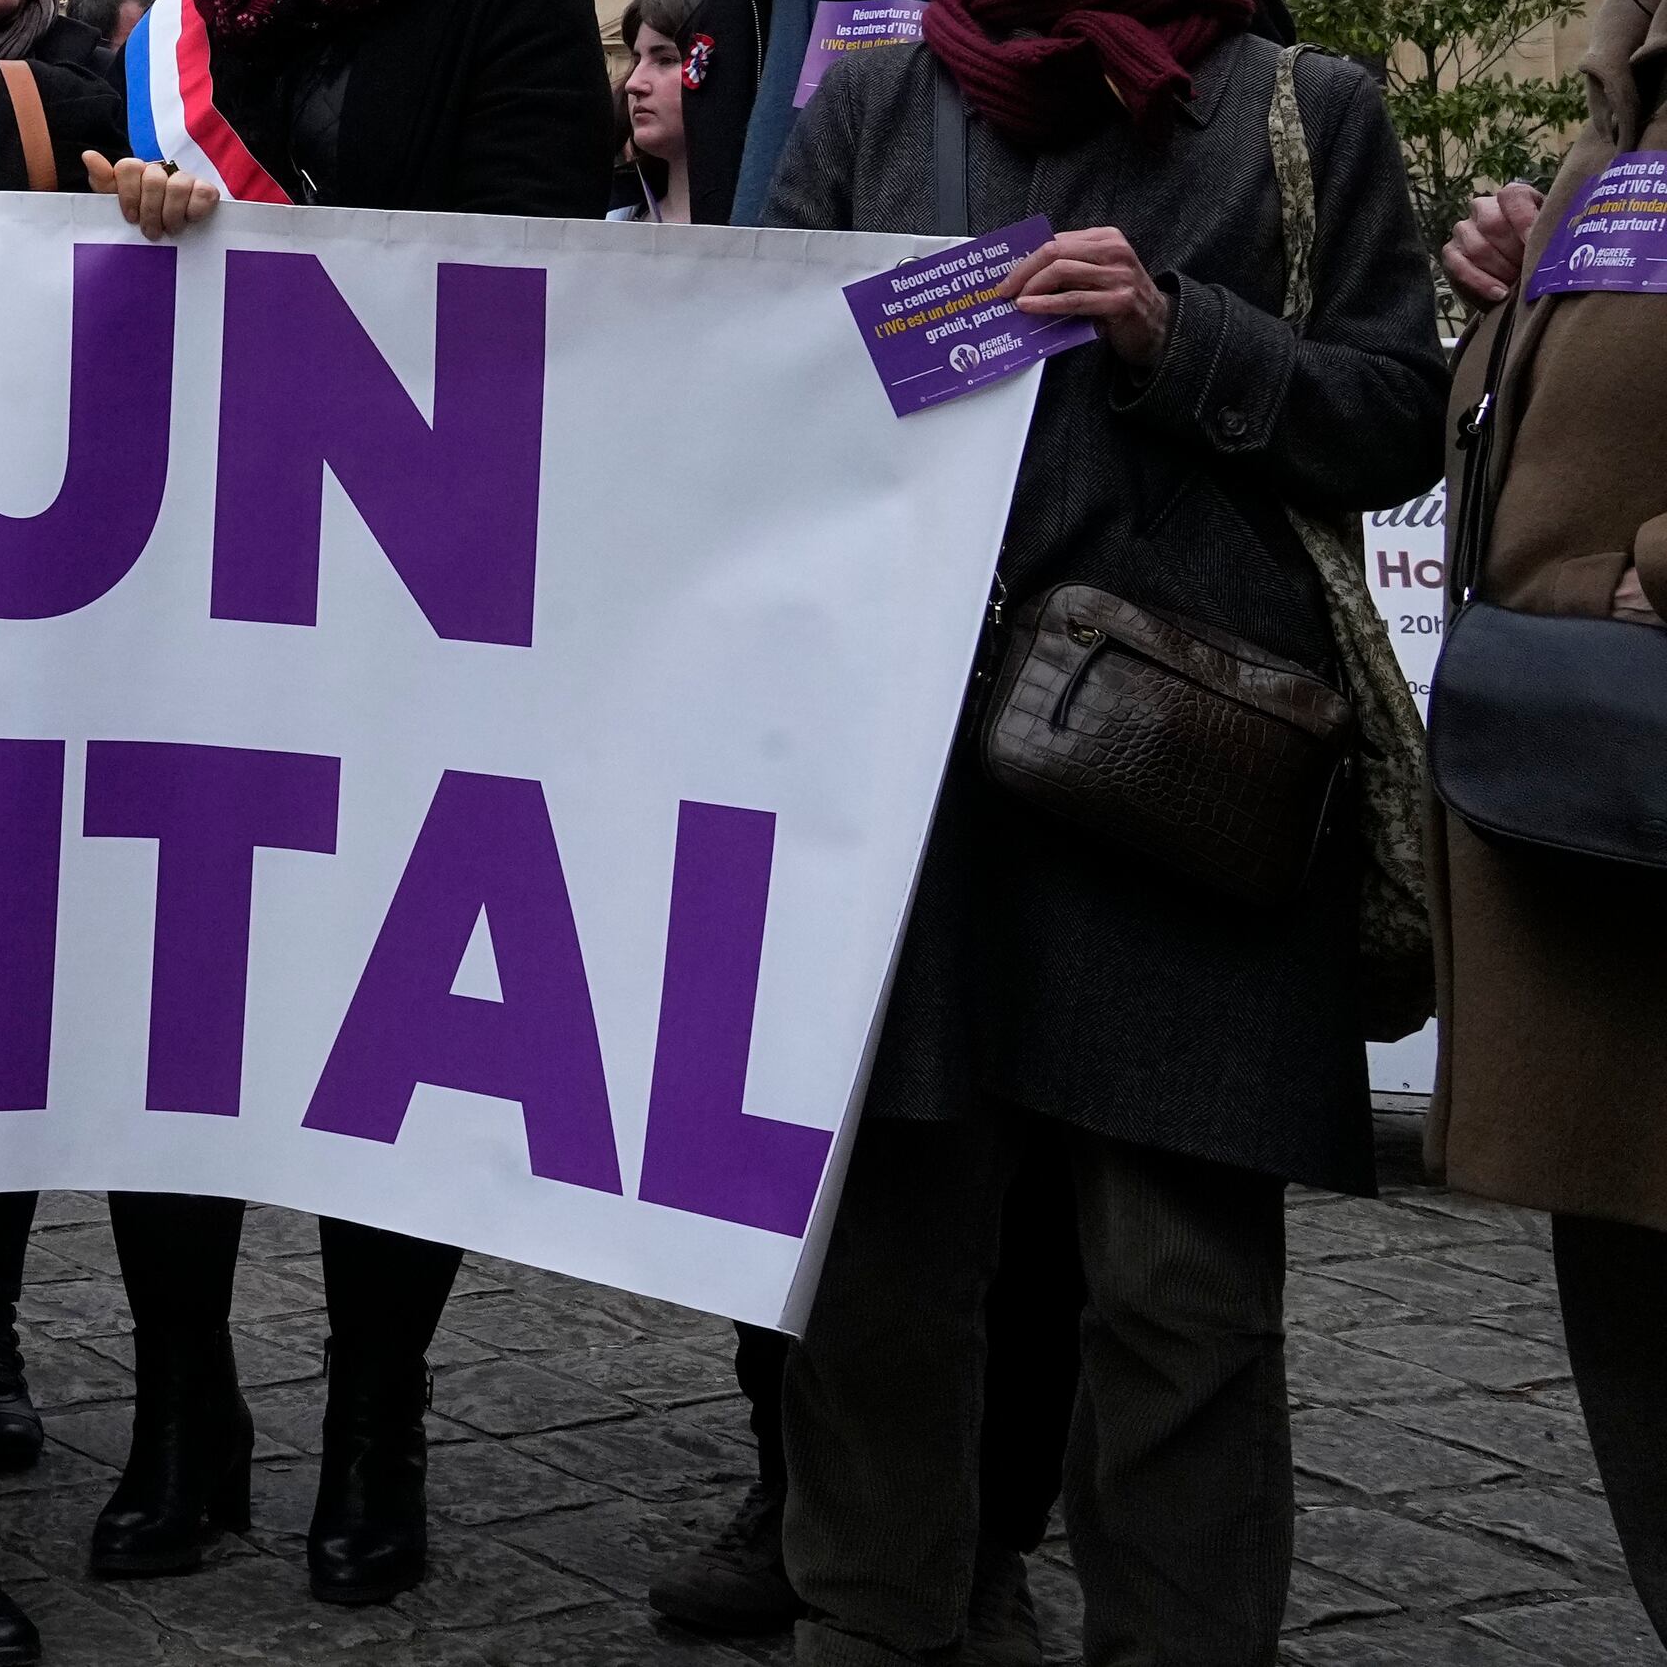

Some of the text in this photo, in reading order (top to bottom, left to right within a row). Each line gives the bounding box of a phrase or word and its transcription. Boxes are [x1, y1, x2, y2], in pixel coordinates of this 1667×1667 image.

[853, 8, 910, 21] Réouverture
[837, 24, 852, 36] les
[853, 23, 886, 36] centres
[887, 22, 916, 35] d'IVG
[846, 39, 861, 51] est
[862, 38, 873, 49] un
[1647, 161, 1665, 175] de
[1618, 179, 1650, 194] d'IVG
[1600, 199, 1627, 213] droit
[1573, 218, 1664, 238] gratuit, partout !
[891, 241, 1009, 293] Réouverture de tous
[1592, 257, 1637, 267] FEMINISTE
[882, 300, 904, 316] les
[904, 283, 951, 309] centres
[951, 269, 985, 293] d'IVG
[906, 312, 928, 328] est
[929, 306, 945, 321] un
[945, 294, 975, 315] droit
[925, 317, 973, 344] gratuit,
[978, 332, 1012, 353] #GREVE
[981, 337, 1023, 361] FEMINISTE
